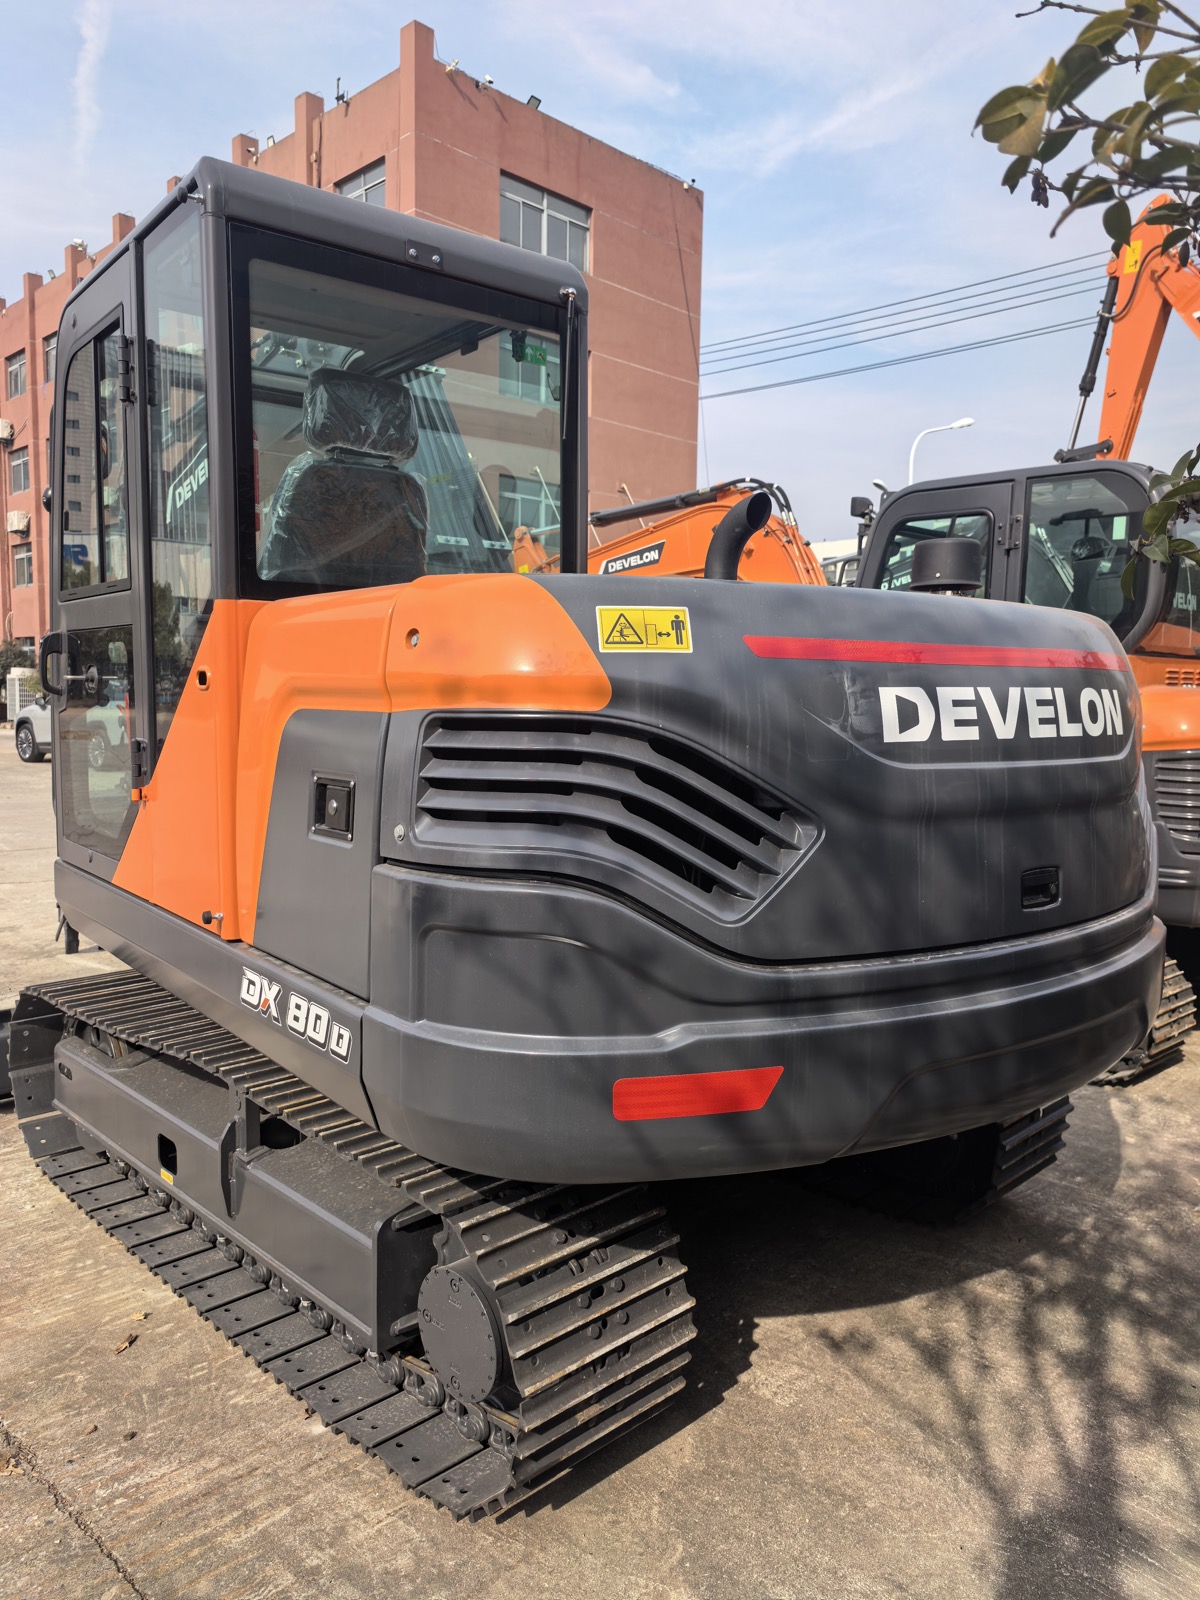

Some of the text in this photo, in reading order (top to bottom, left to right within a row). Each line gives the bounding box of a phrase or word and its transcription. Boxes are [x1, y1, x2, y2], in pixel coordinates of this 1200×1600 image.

[608, 549, 659, 573] DEVELON
[878, 686, 1124, 743] DEVELON
[240, 966, 283, 1026] DX
